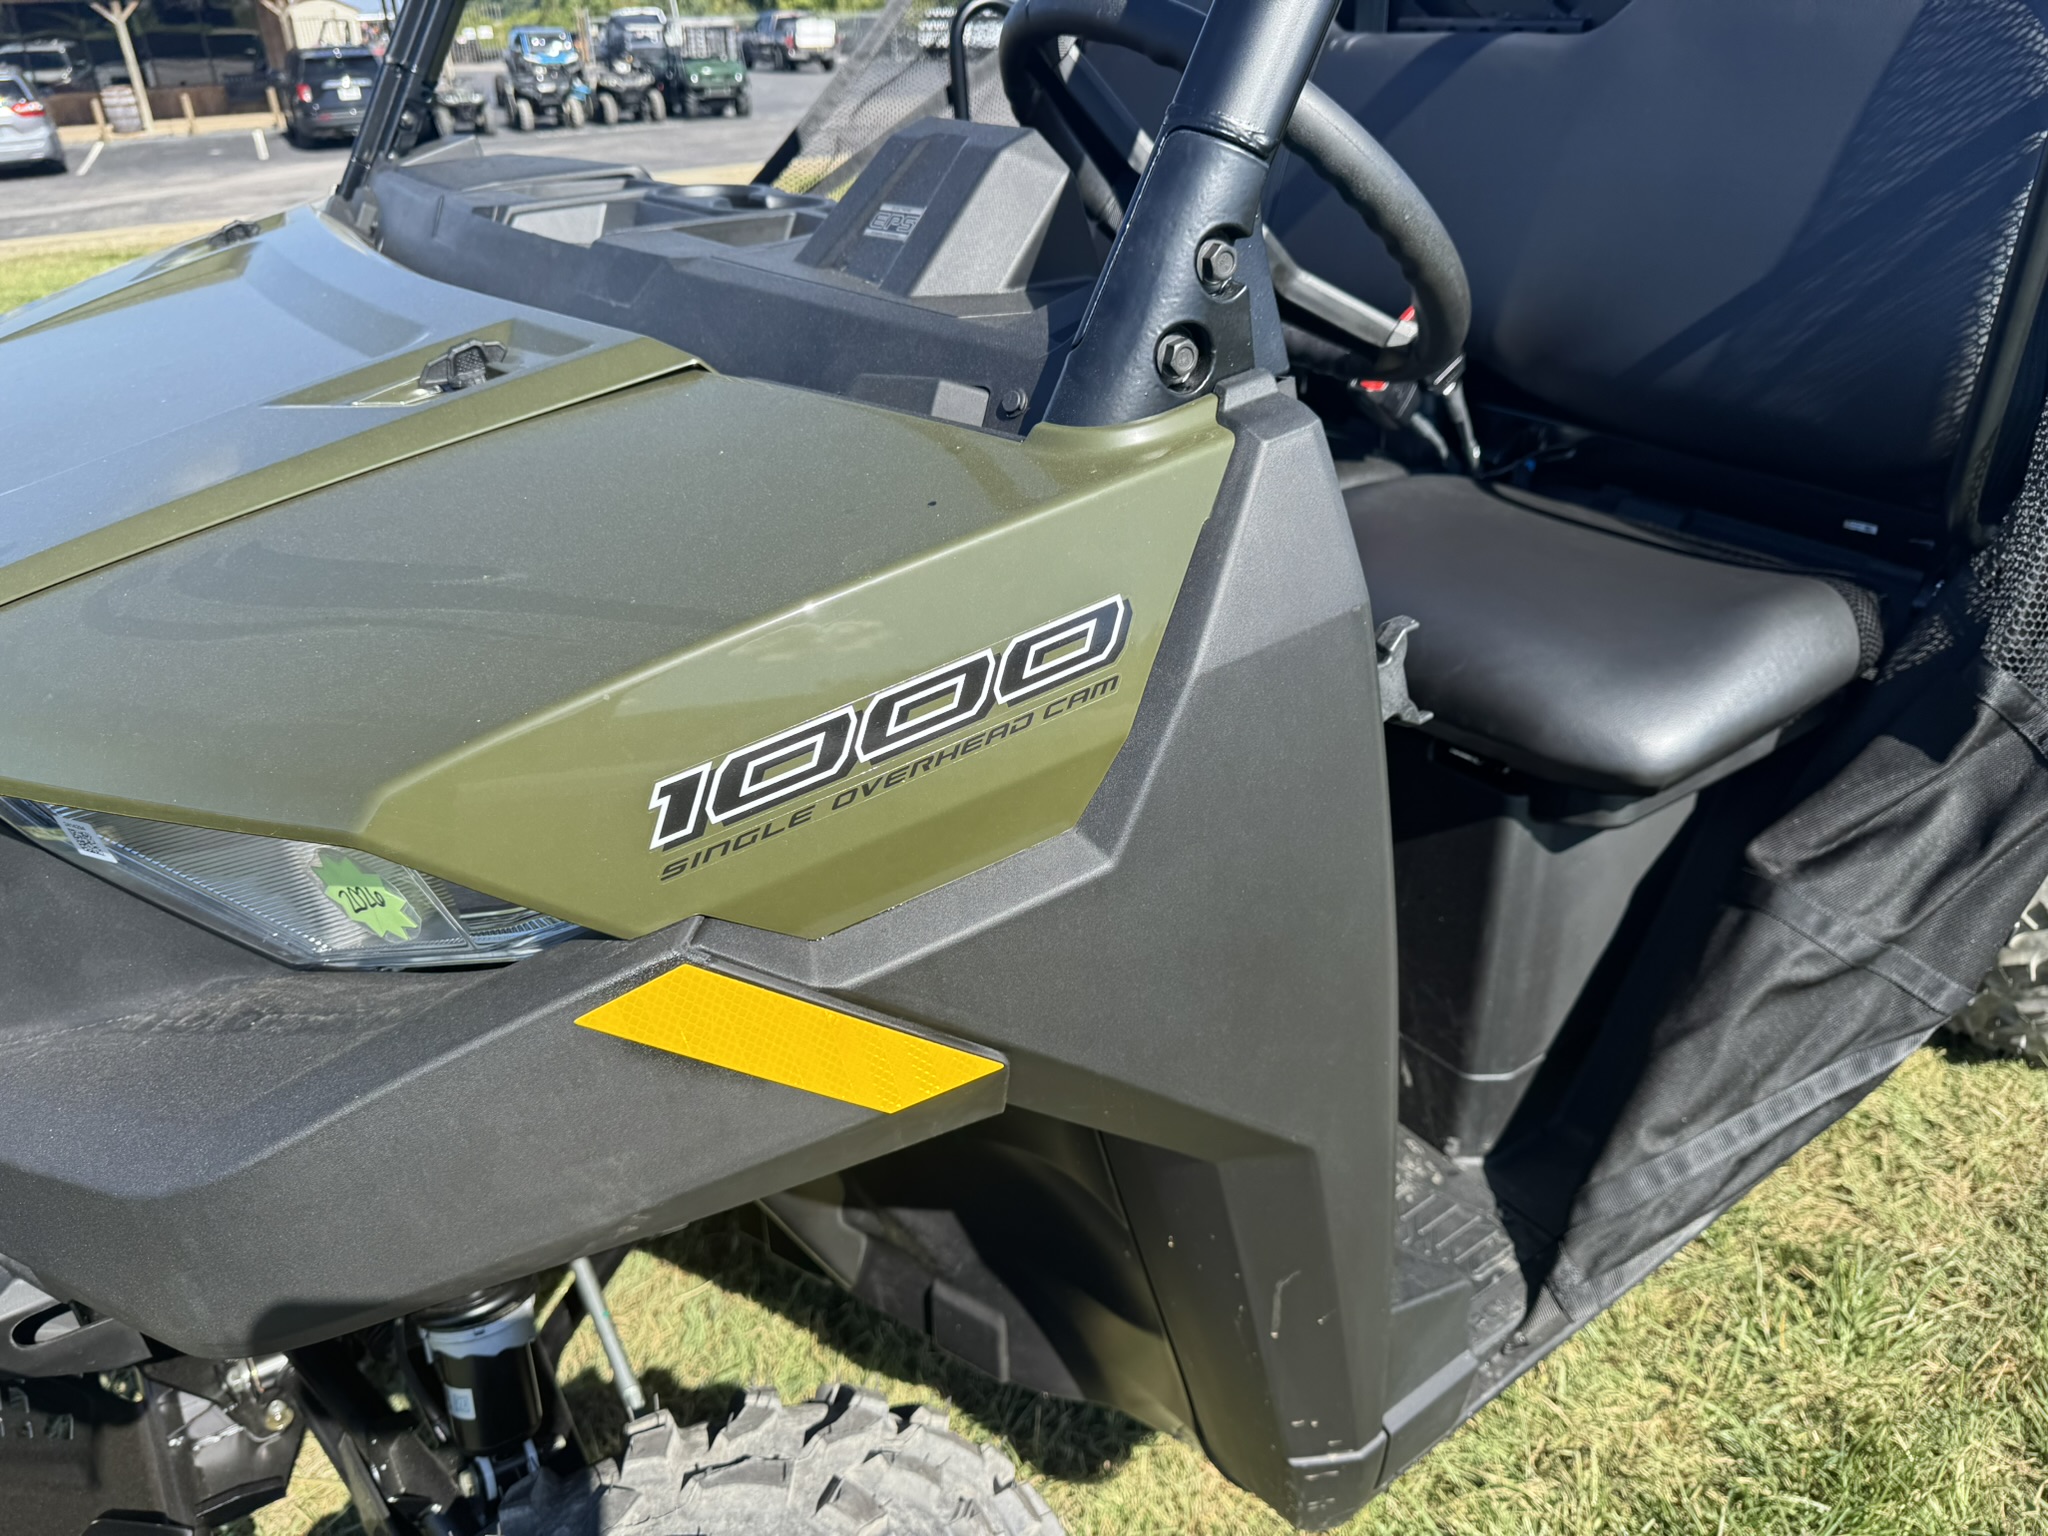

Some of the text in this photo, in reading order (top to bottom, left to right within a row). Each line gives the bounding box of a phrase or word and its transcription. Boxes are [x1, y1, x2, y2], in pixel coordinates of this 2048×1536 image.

[869, 211, 920, 232] EPS
[648, 593, 1133, 852] 1000
[660, 675, 1120, 881] SINGLE OVERHEAD CAM
